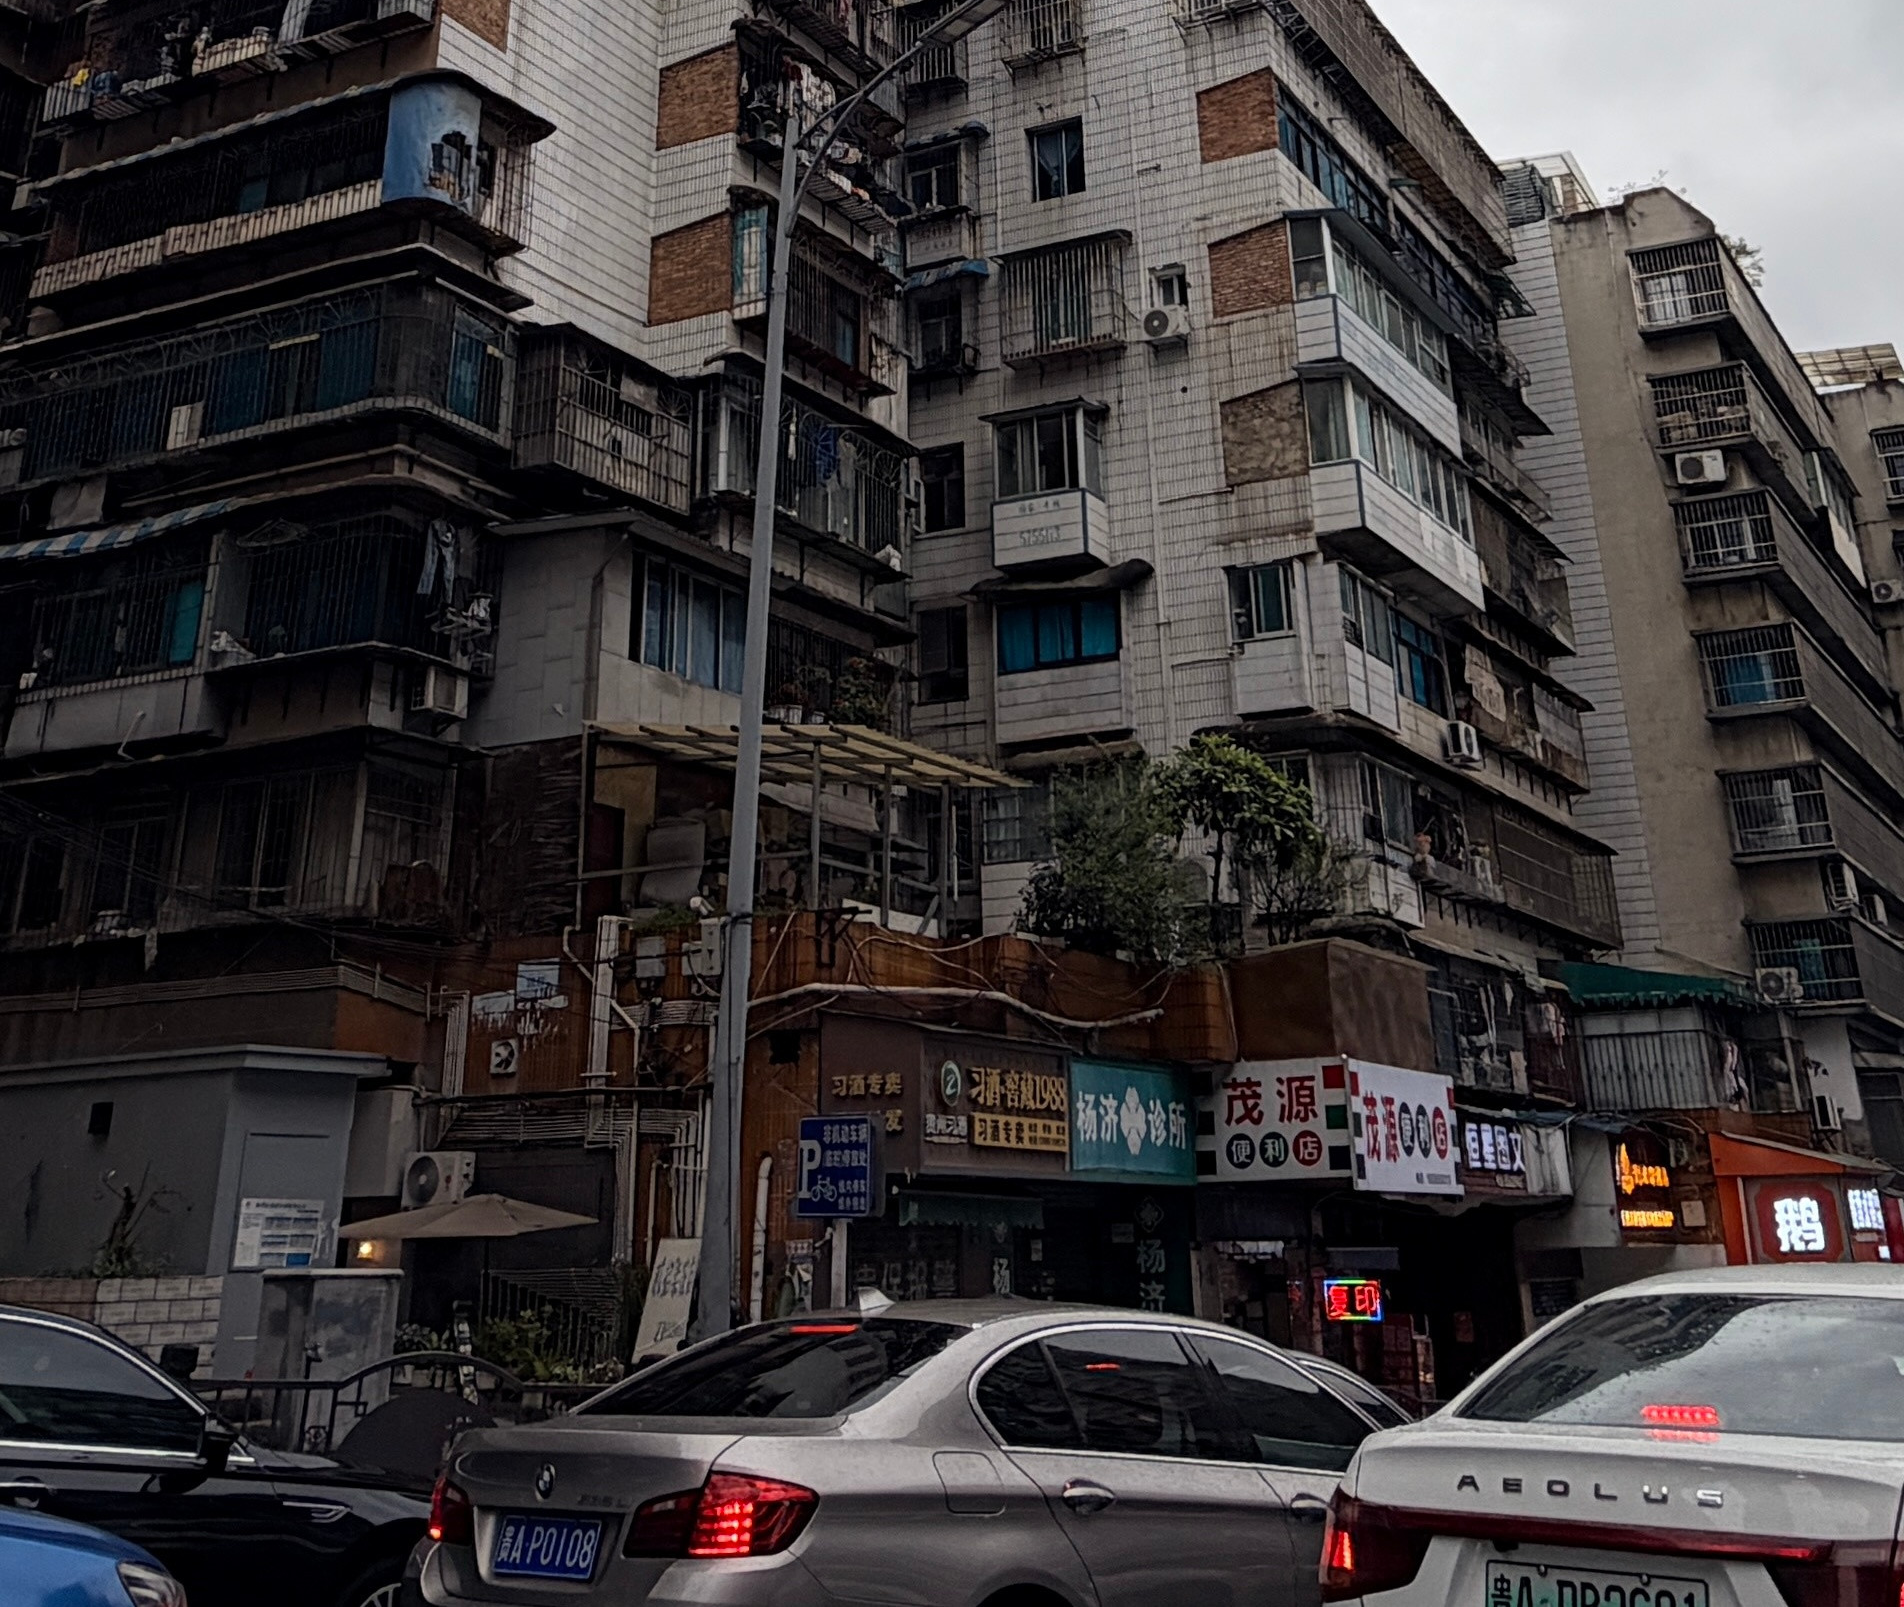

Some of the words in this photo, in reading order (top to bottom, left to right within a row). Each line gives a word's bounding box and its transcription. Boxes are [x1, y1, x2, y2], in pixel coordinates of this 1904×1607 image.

[831, 1071, 903, 1097] 习酒专卖
[1221, 1075, 1320, 1128] 茂源
[1076, 1090, 1119, 1145] 杨济
[1147, 1098, 1187, 1151] 诊所
[1230, 1135, 1321, 1164] 便利店
[798, 1138, 822, 1199] P
[1328, 1285, 1377, 1317] 复印
[1456, 1473, 1725, 1509] AEOLUS
